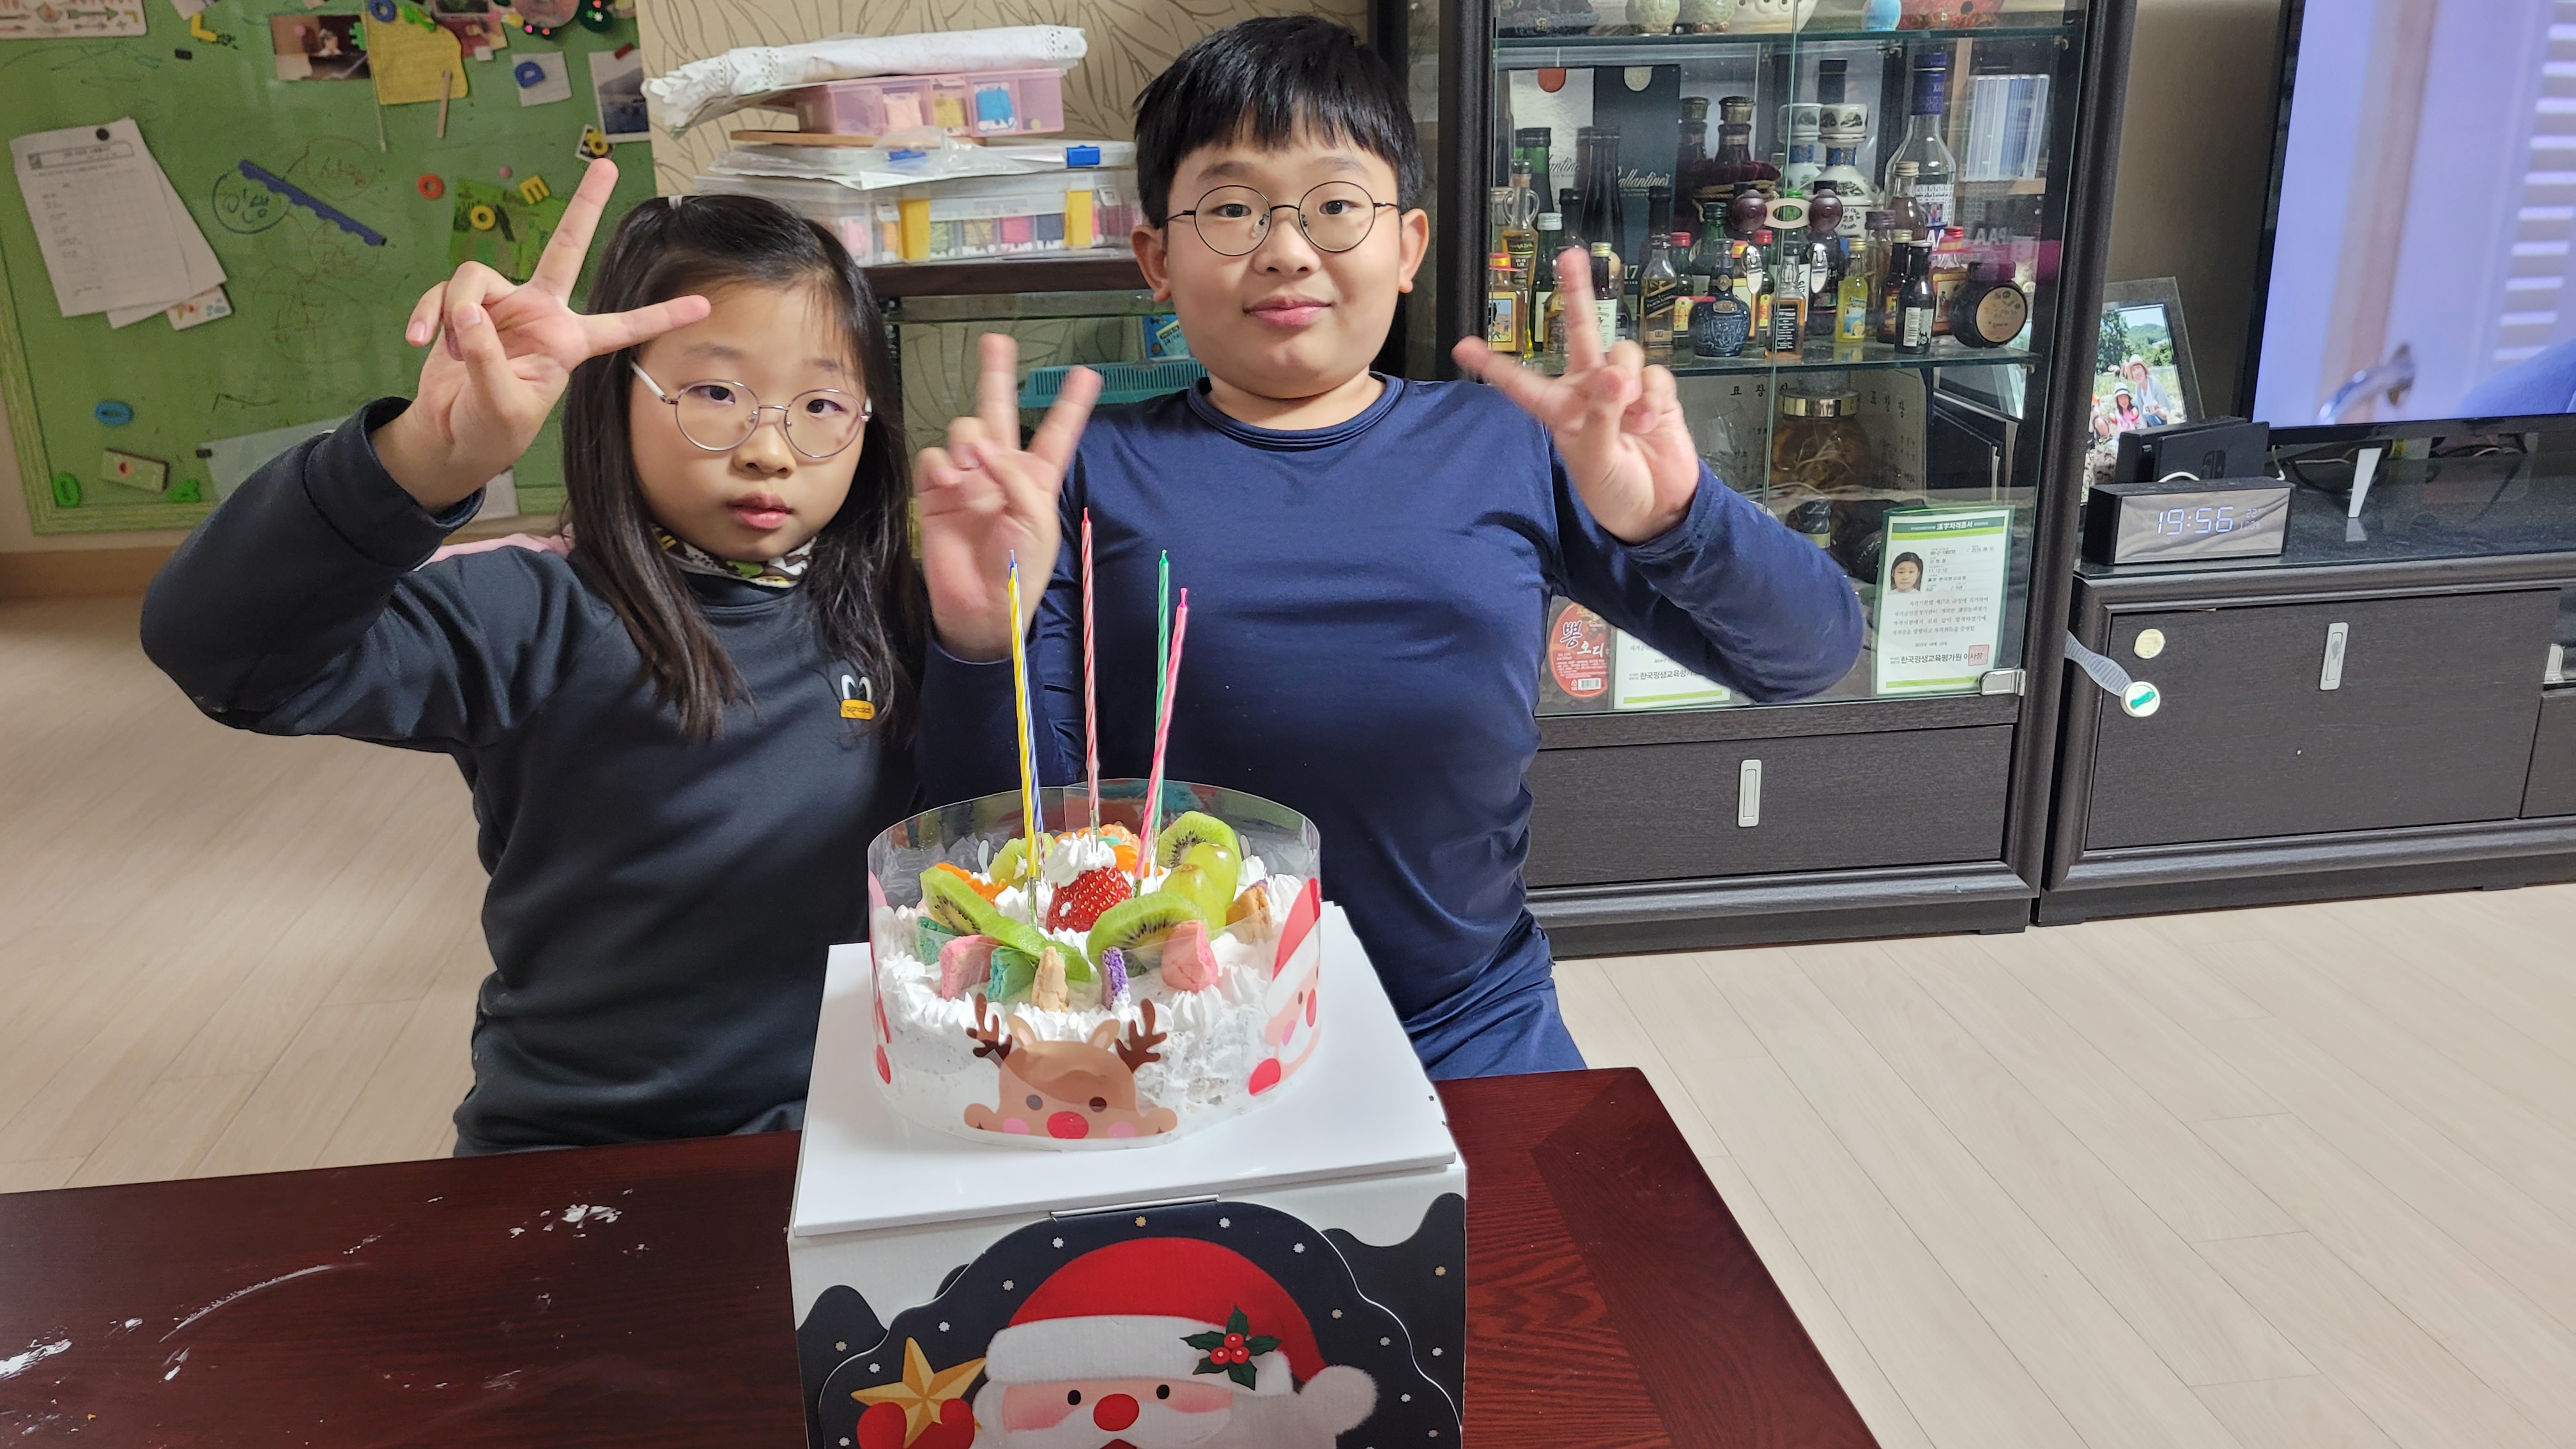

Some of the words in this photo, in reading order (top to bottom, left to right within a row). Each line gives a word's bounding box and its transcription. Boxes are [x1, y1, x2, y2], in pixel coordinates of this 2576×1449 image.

[1625, 265, 1639, 279] 17
[2158, 507, 2234, 535] 19:56
[1901, 653, 1962, 664] 한국평생교육평가원
[1963, 652, 1983, 661] 이사장
[1640, 670, 1698, 680] 한국평생교육평가
